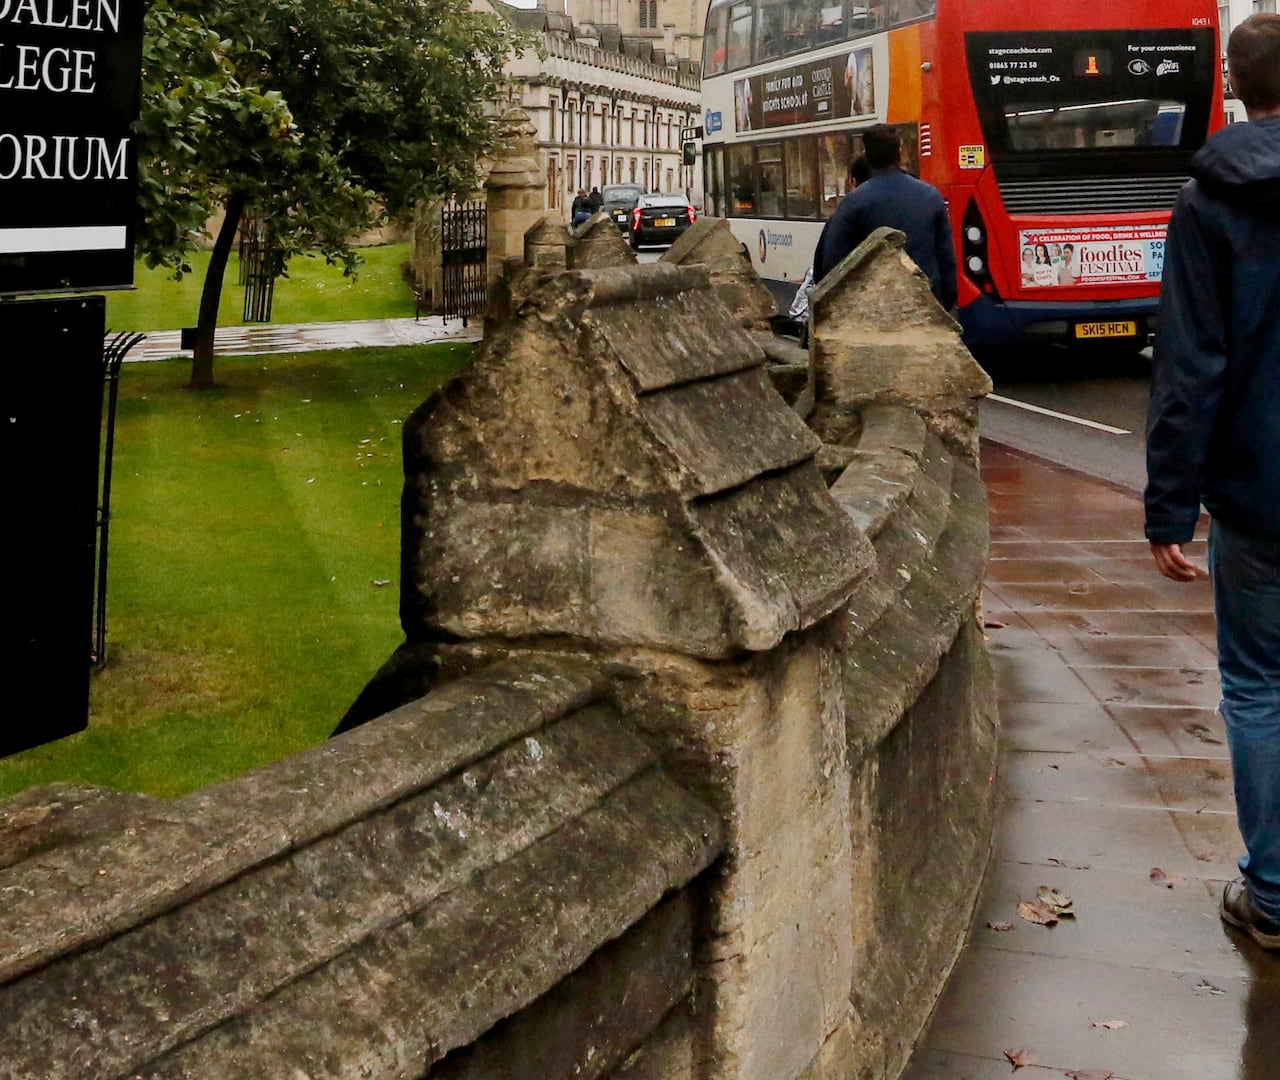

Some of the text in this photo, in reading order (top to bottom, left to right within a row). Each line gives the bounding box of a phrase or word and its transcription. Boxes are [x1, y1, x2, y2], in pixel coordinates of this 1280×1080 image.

[988, 47, 1053, 56] stagecoachbus.com
[1127, 44, 1140, 52] For
[1156, 44, 1196, 52] convenience
[812, 82, 833, 98] CASTLE
[781, 94, 802, 110] SCHOOL
[1038, 234, 1081, 242] CELEBRATION
[1091, 233, 1113, 241] FOOD,
[1139, 231, 1167, 239] WELLBEIN
[1150, 241, 1164, 250] SO
[1080, 244, 1142, 263] foodies
[1152, 251, 1163, 259] PA
[1080, 262, 1142, 274] FESTIVAL
[1082, 322, 1129, 336] SK15 HCN
